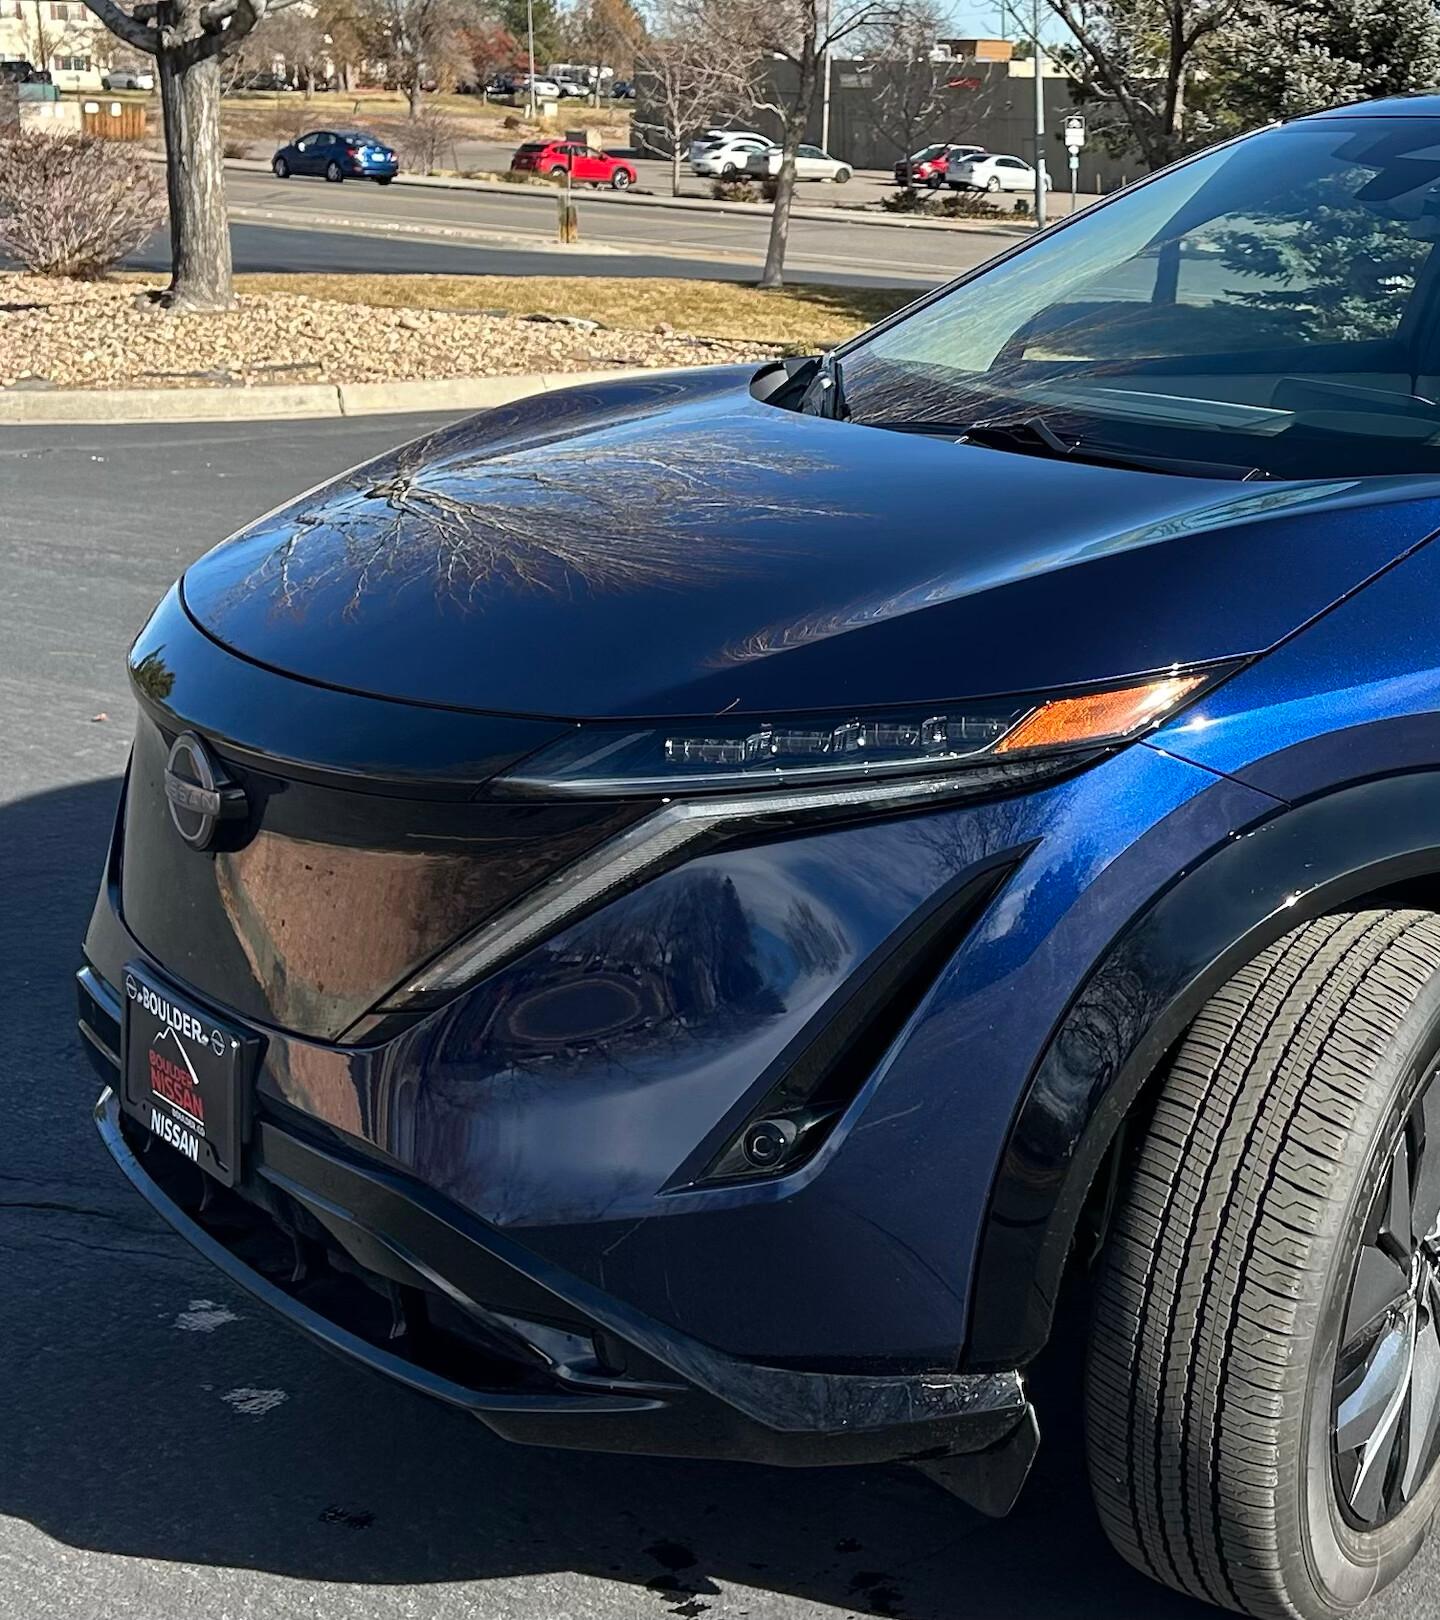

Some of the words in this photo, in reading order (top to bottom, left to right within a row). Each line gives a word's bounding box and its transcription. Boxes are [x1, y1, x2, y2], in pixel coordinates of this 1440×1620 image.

[142, 985, 203, 1044] BOULDER
[148, 1048, 194, 1089] BOULDER
[151, 1066, 204, 1122] NISSAN
[151, 1109, 200, 1163] NISSAN
